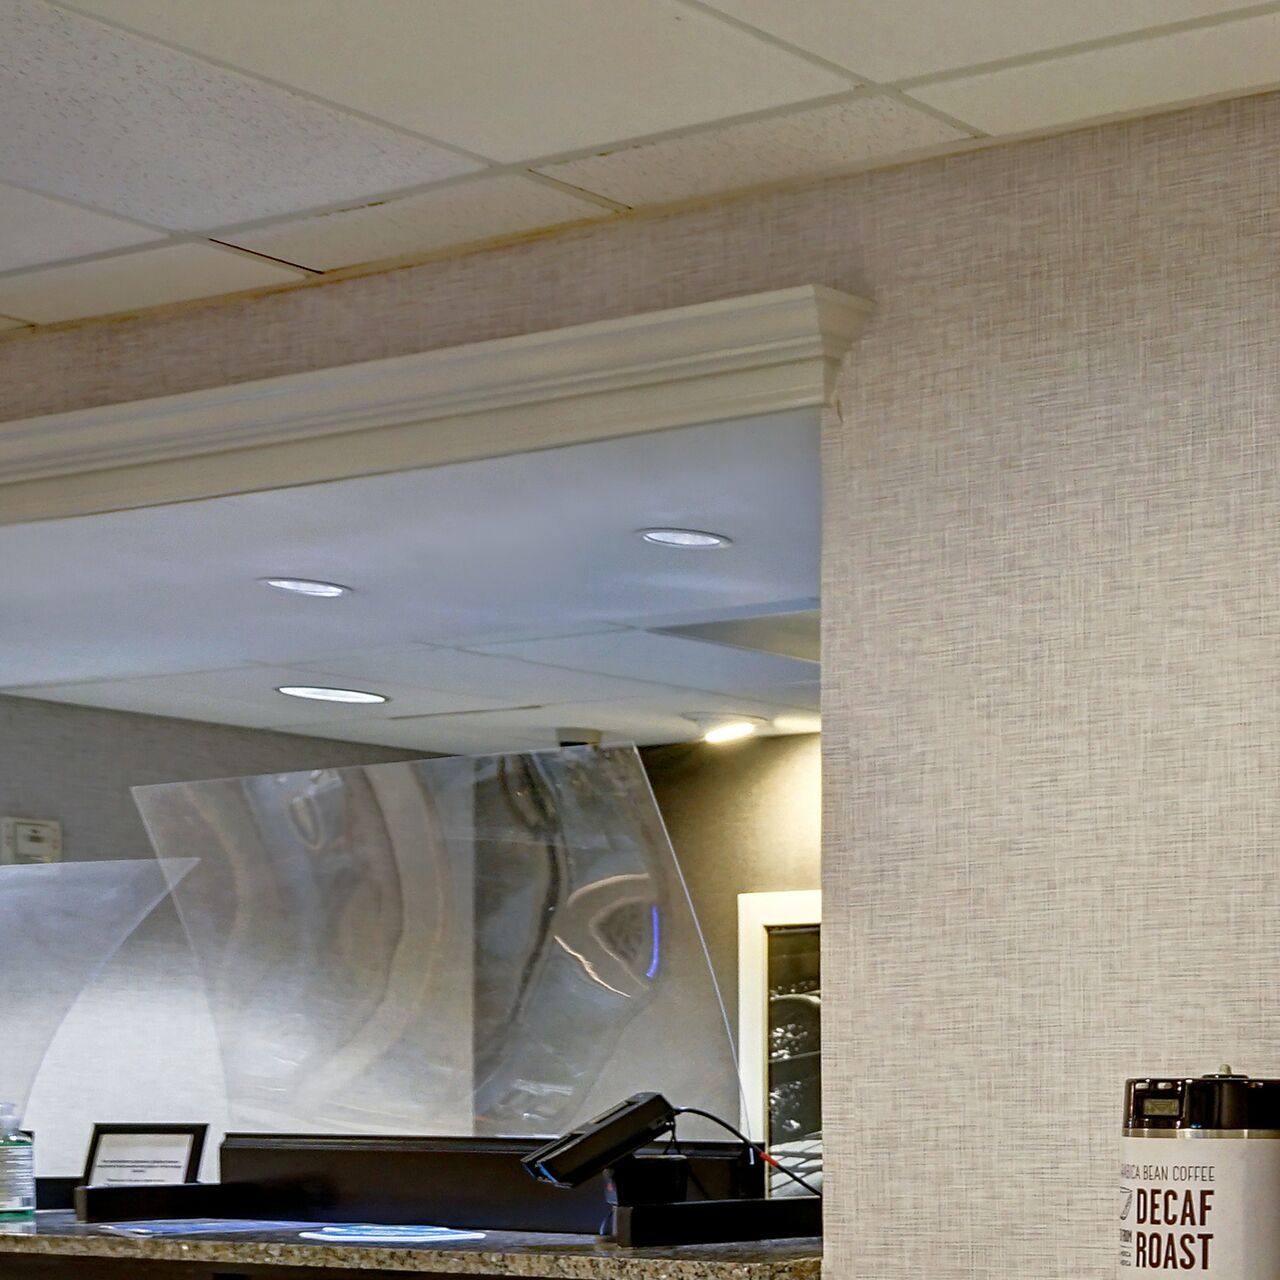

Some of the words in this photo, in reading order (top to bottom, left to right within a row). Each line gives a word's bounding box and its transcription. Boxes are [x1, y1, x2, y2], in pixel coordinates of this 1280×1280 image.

[1144, 1165, 1168, 1181] BEAN
[1172, 1166, 1216, 1182] COFFEE
[1136, 1188, 1215, 1226] DECAF
[1136, 1231, 1214, 1270] ROAST
